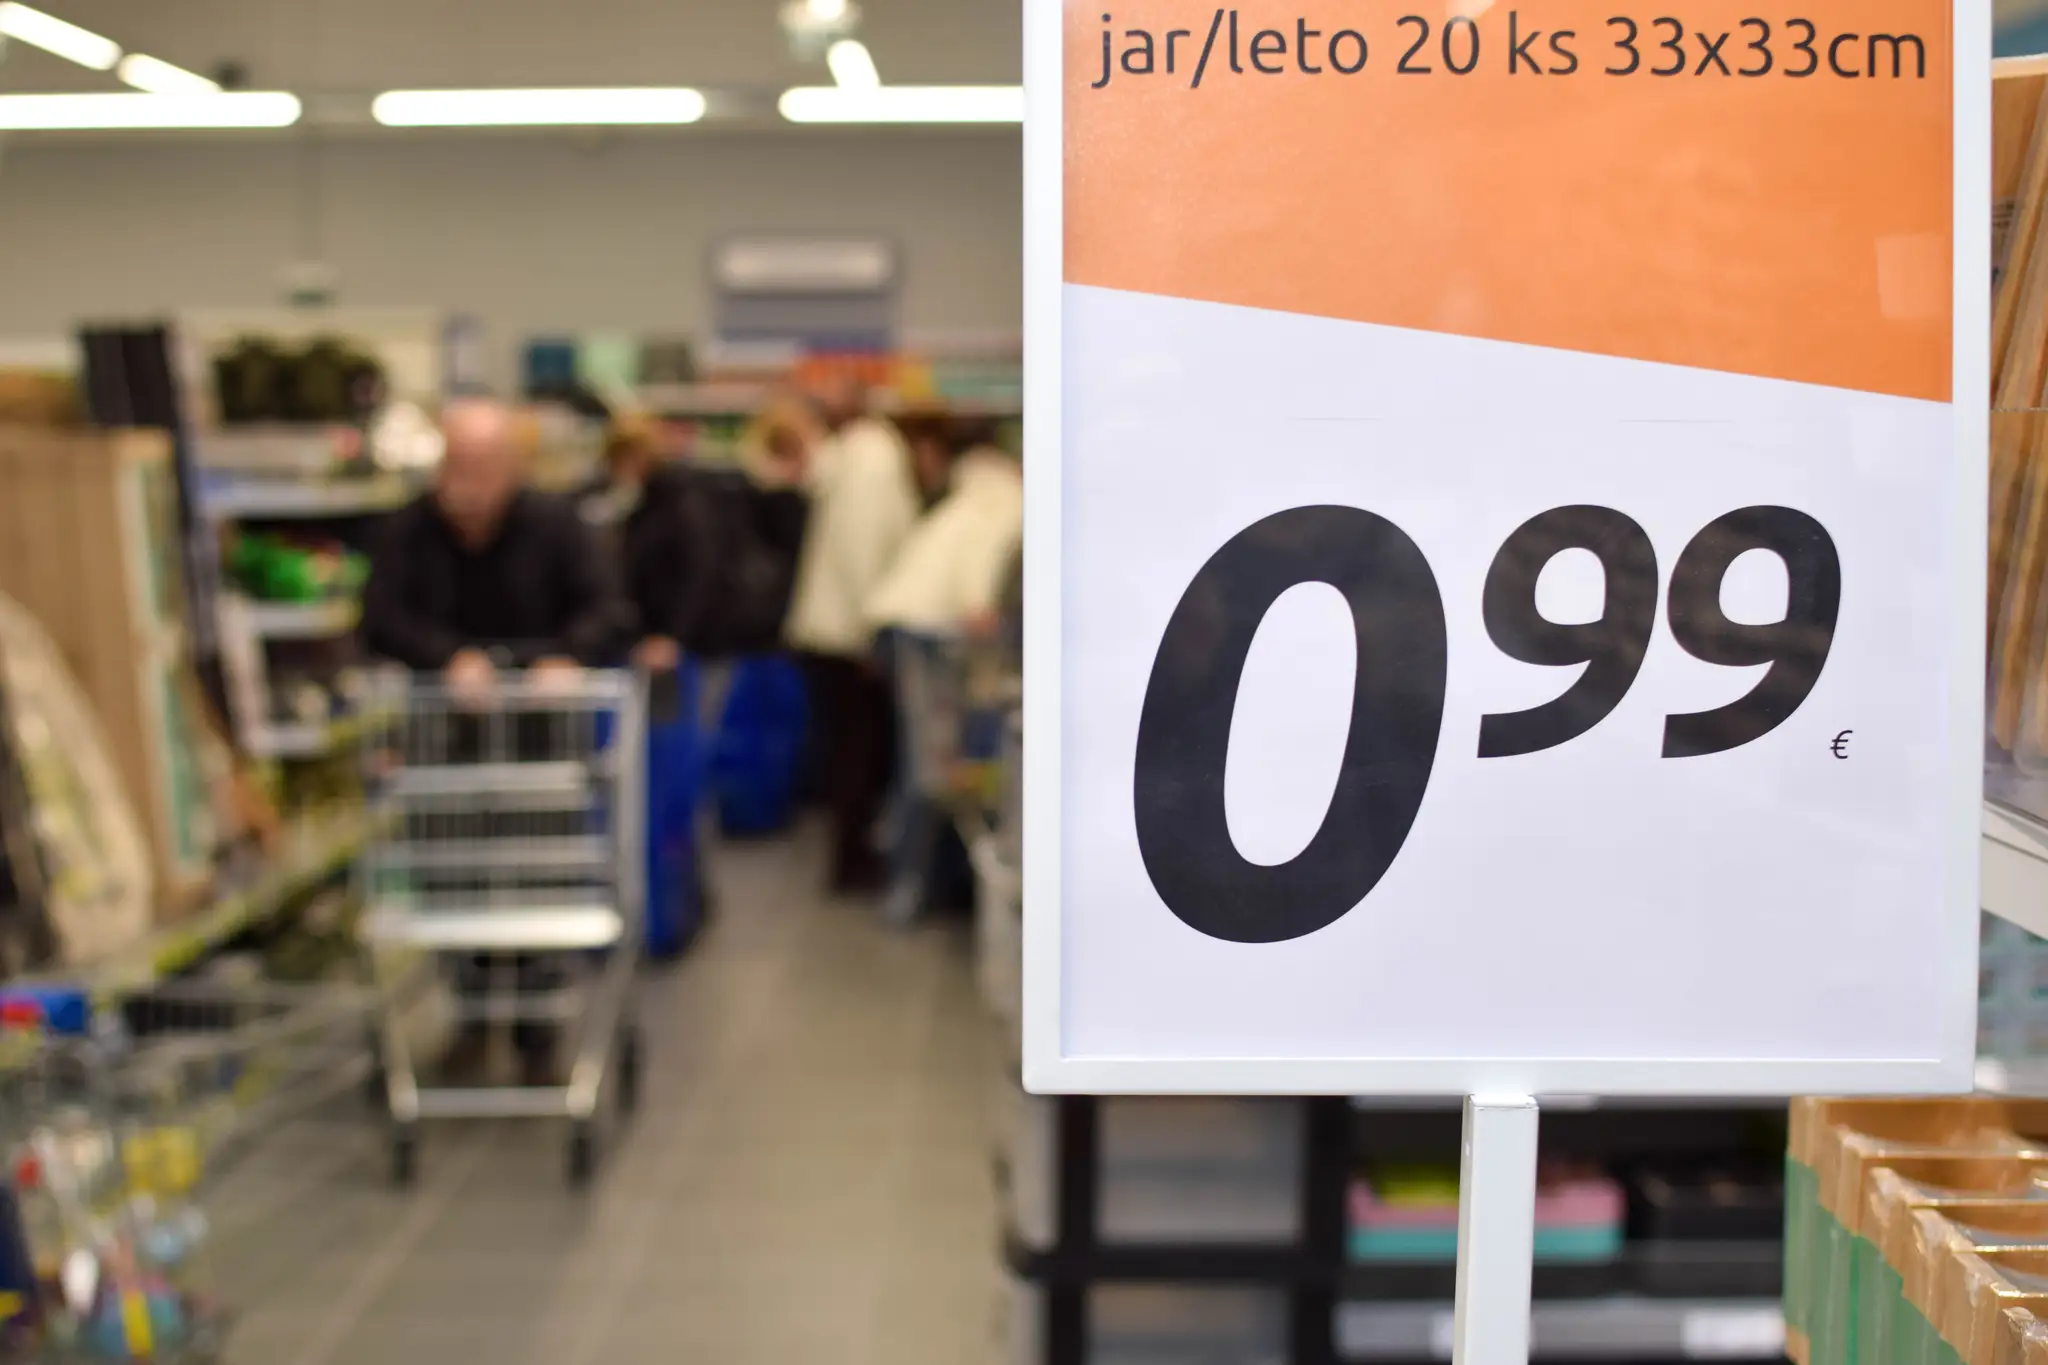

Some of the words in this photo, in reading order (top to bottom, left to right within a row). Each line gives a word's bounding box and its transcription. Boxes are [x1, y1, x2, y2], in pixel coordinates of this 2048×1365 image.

[1091, 9, 1368, 89] jar/leto
[1396, 15, 1480, 75] 20
[1508, 10, 1578, 75] ks
[1605, 16, 1926, 79] 33x33cm
[1829, 729, 1853, 760] €
